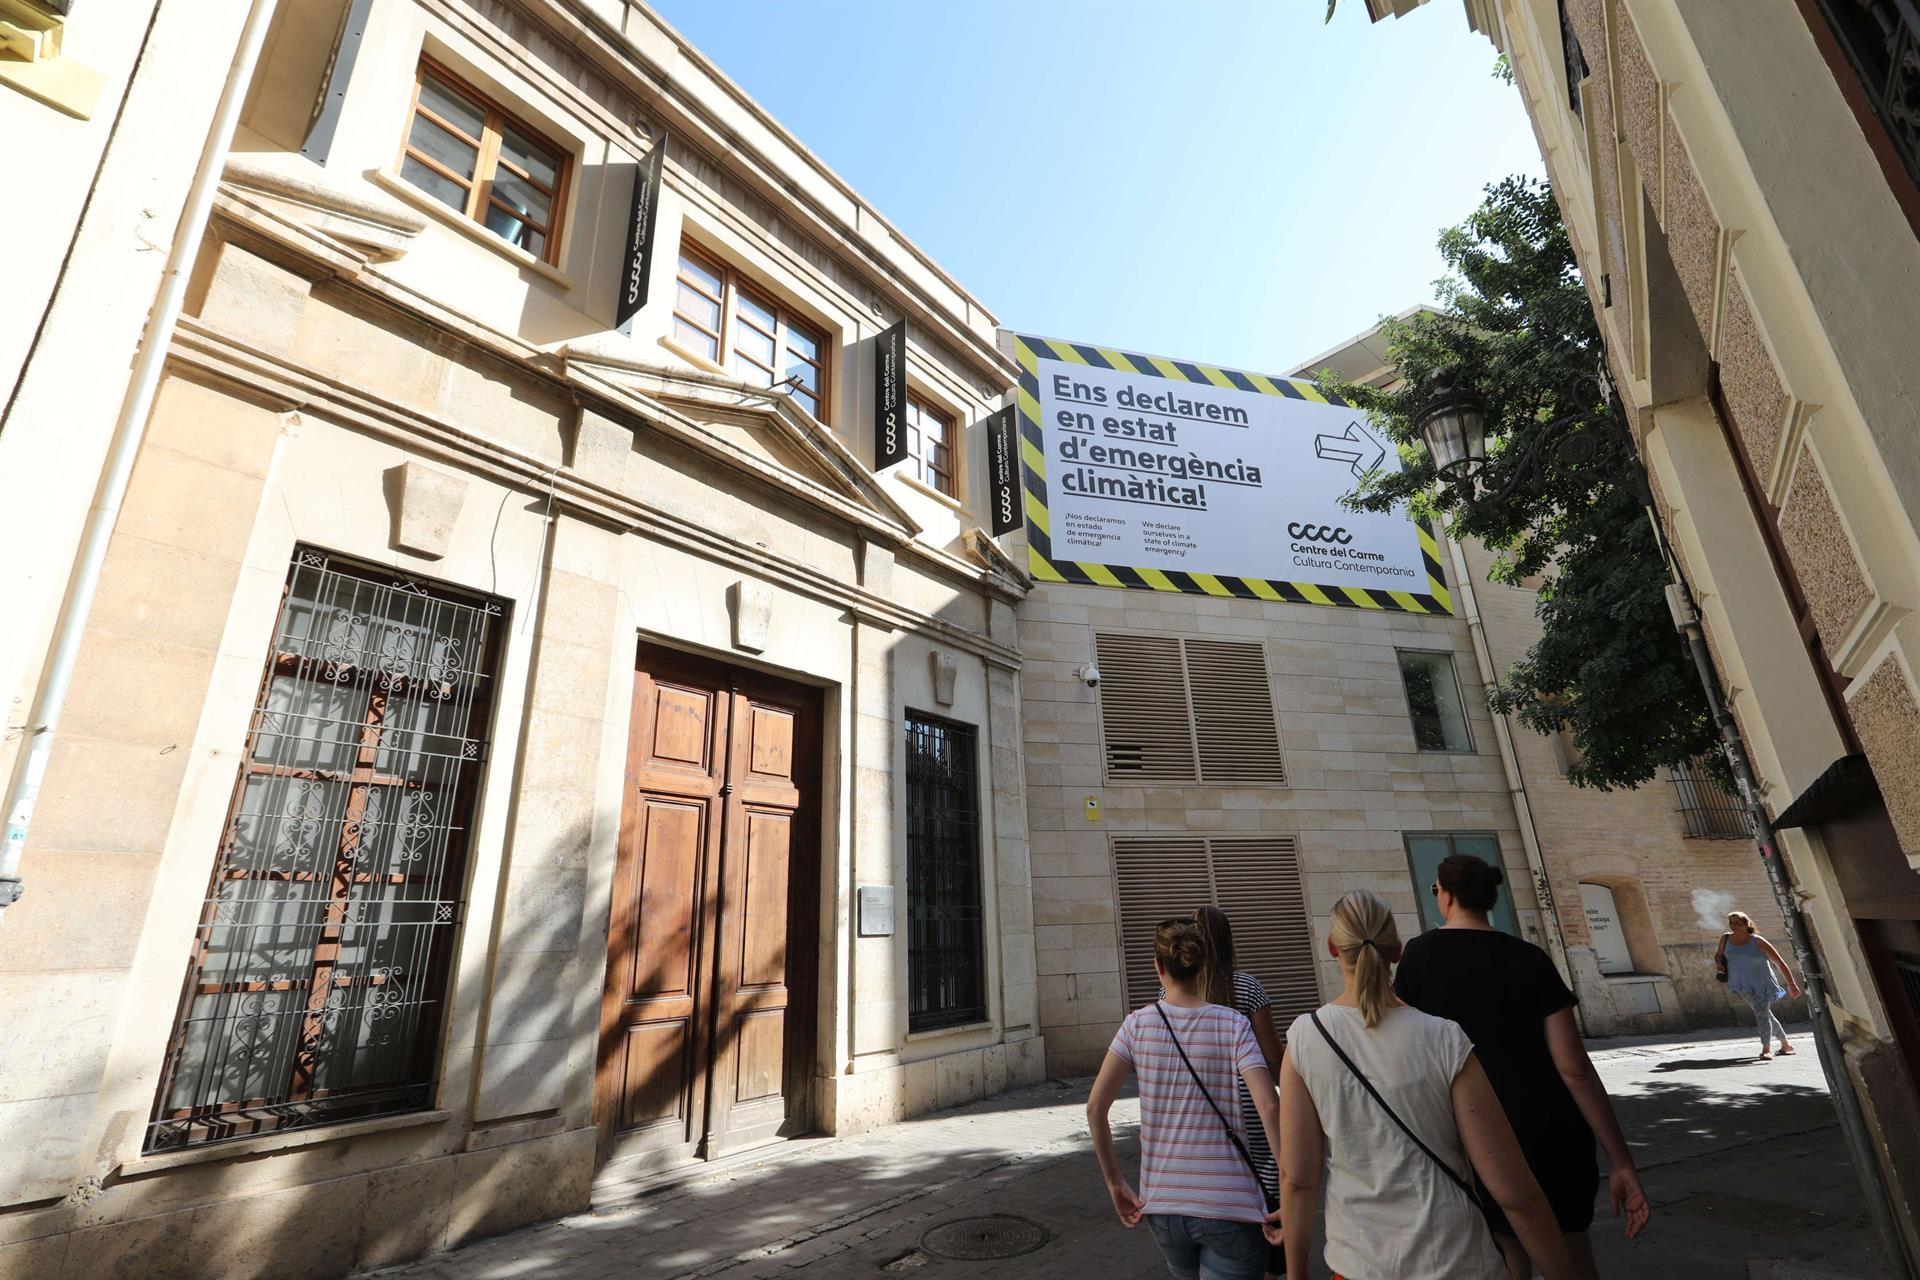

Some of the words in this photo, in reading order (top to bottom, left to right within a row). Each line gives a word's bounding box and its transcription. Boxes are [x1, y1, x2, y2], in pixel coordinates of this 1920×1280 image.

[1053, 374, 1108, 403] Ens
[1116, 385, 1249, 424] declarem
[1056, 409, 1095, 431] en
[1102, 415, 1178, 443] estat
[1061, 468, 1208, 507] climàtica!
[1083, 515, 1126, 525] declaramos
[1077, 522, 1103, 531] estado
[1141, 521, 1154, 529] We
[1155, 523, 1181, 531] declare
[1078, 530, 1121, 541] emergencia
[1143, 530, 1177, 539] ourselves
[1171, 540, 1197, 549] climate
[1144, 546, 1187, 557] emergency!
[1290, 543, 1328, 556] Centre
[1330, 546, 1347, 557] del
[1348, 549, 1385, 562] Carme
[1293, 556, 1333, 569] Cultura
[1334, 560, 1415, 577] Contemporània
